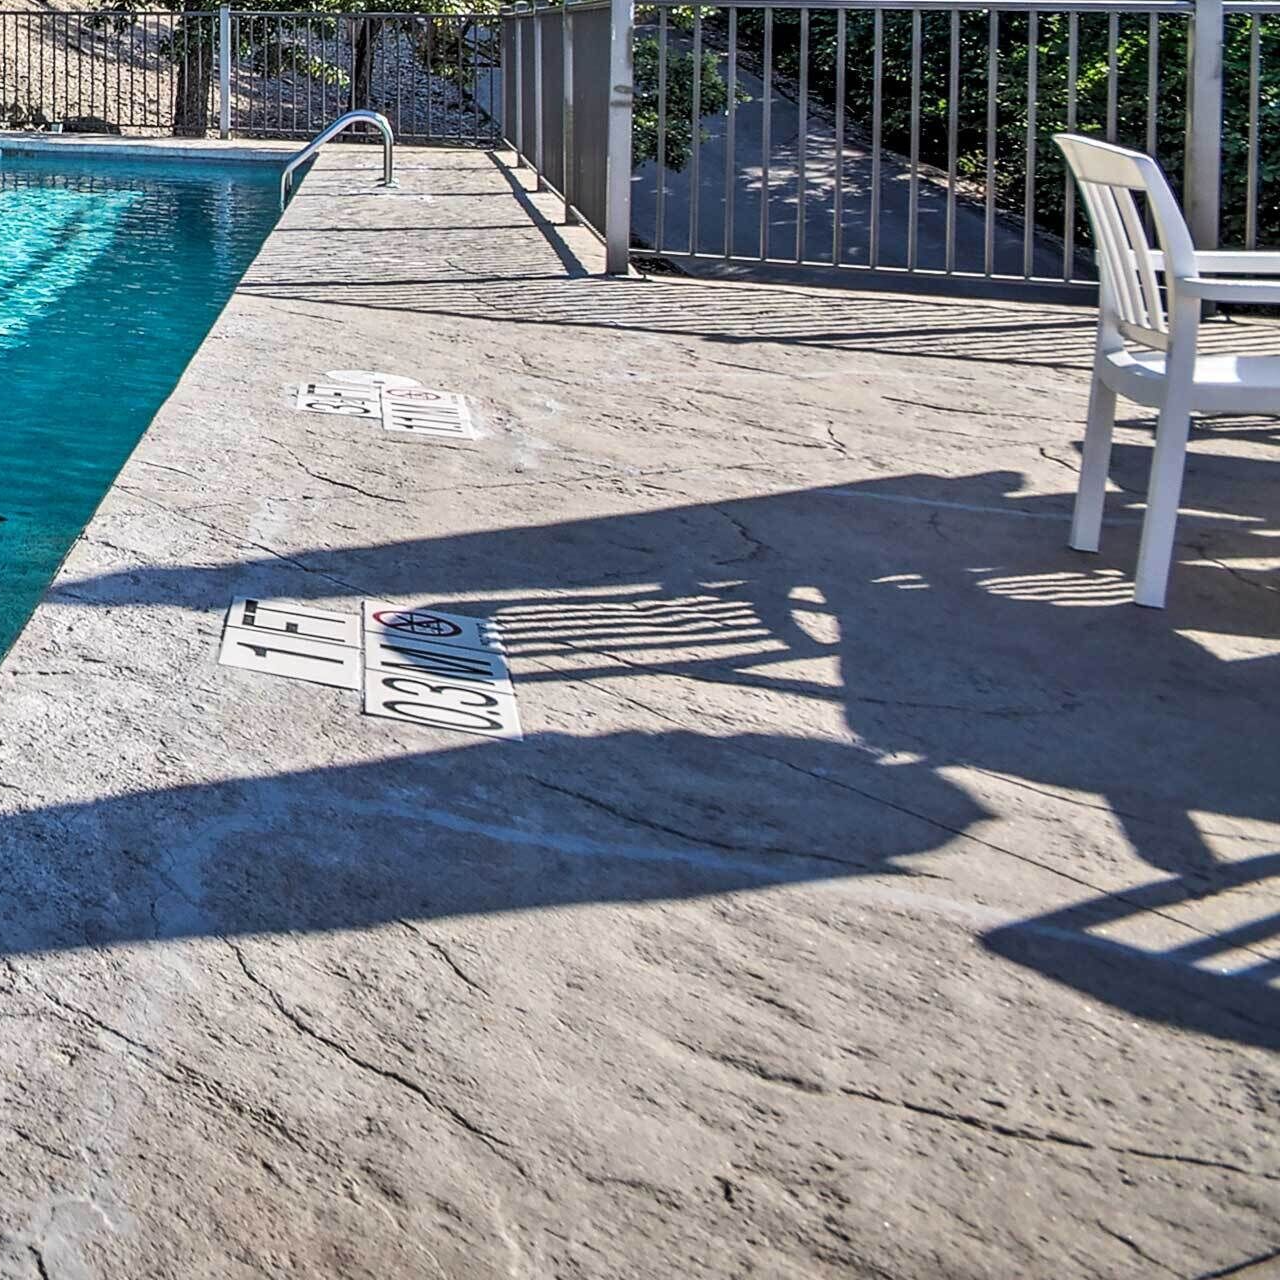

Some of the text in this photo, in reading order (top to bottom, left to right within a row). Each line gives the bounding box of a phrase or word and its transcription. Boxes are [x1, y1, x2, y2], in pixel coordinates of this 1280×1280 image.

[236, 599, 346, 665] 1 FT
[380, 643, 504, 731] 0.3M
